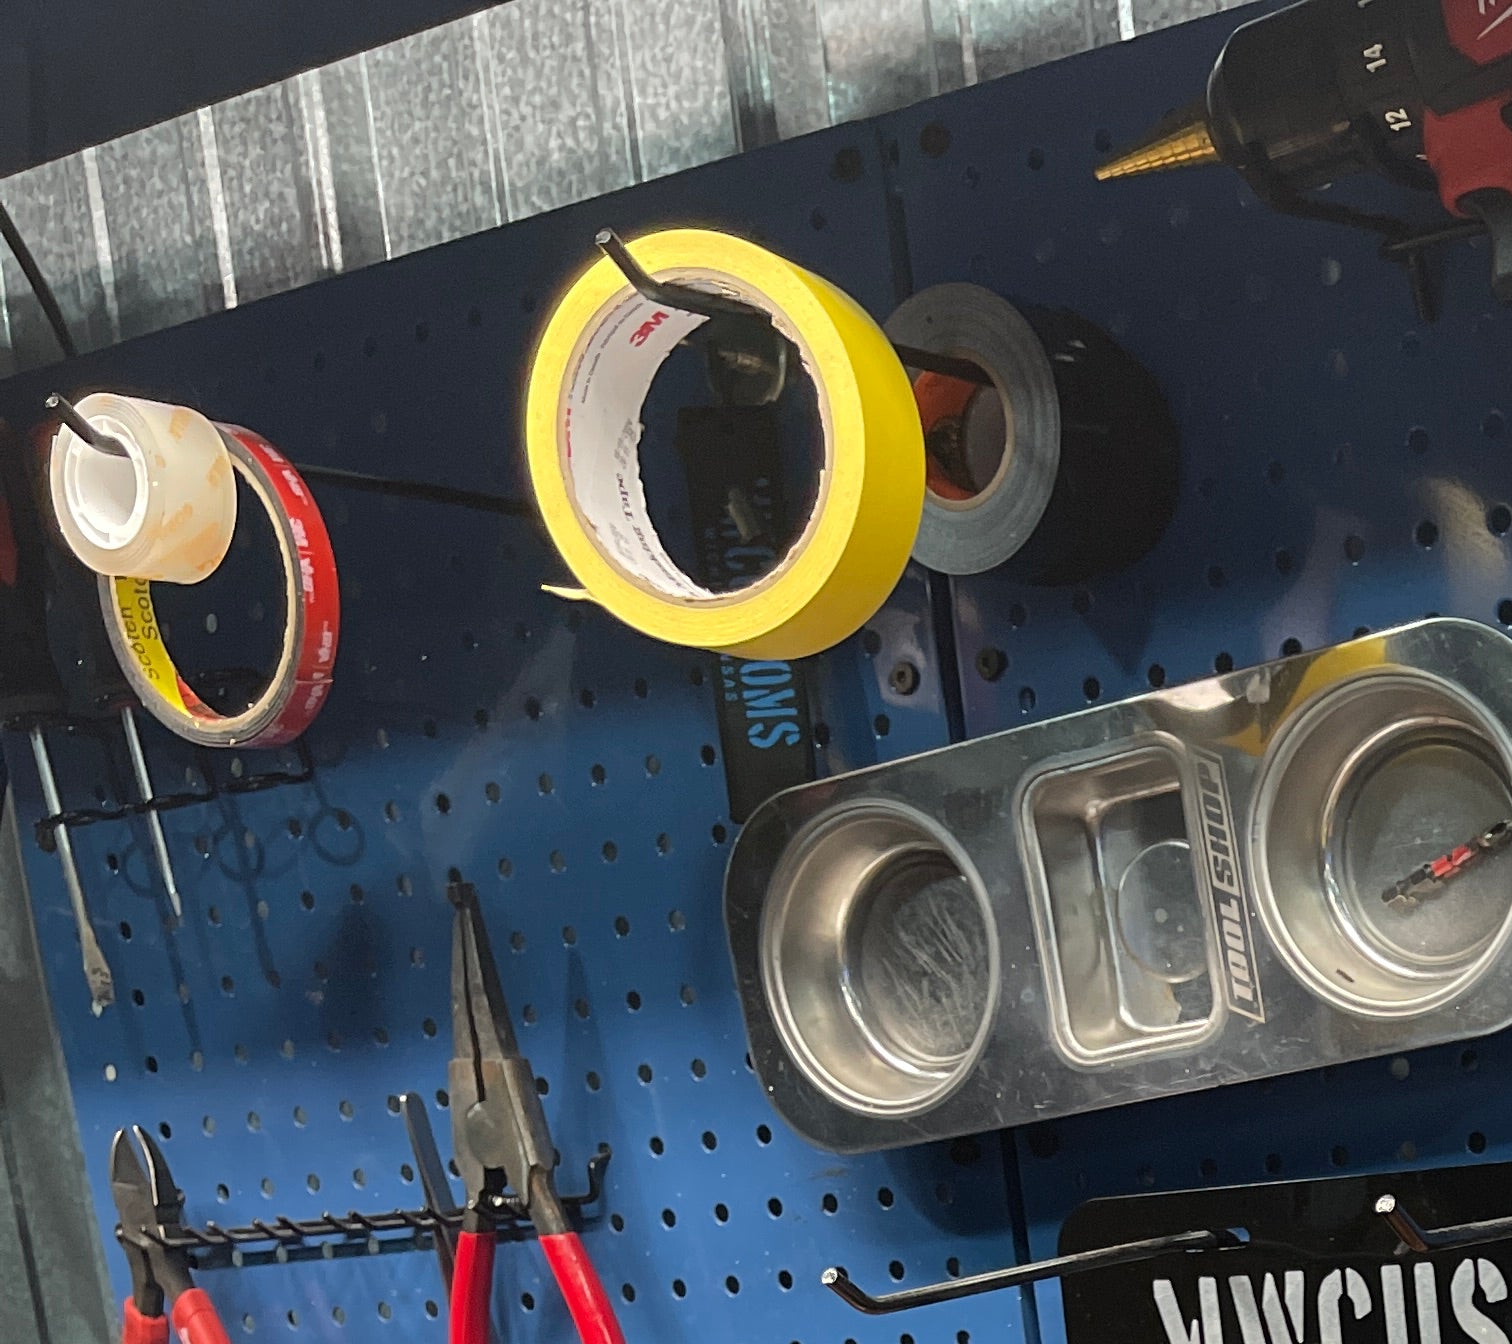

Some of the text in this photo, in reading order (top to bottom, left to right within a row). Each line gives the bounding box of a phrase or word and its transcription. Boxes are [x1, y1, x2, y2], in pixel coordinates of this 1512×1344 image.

[1363, 43, 1387, 73] 14
[1385, 108, 1412, 131] 12
[629, 310, 670, 348] 3M
[134, 577, 160, 641] Scotc
[1197, 760, 1256, 1002] TOOL SHOP
